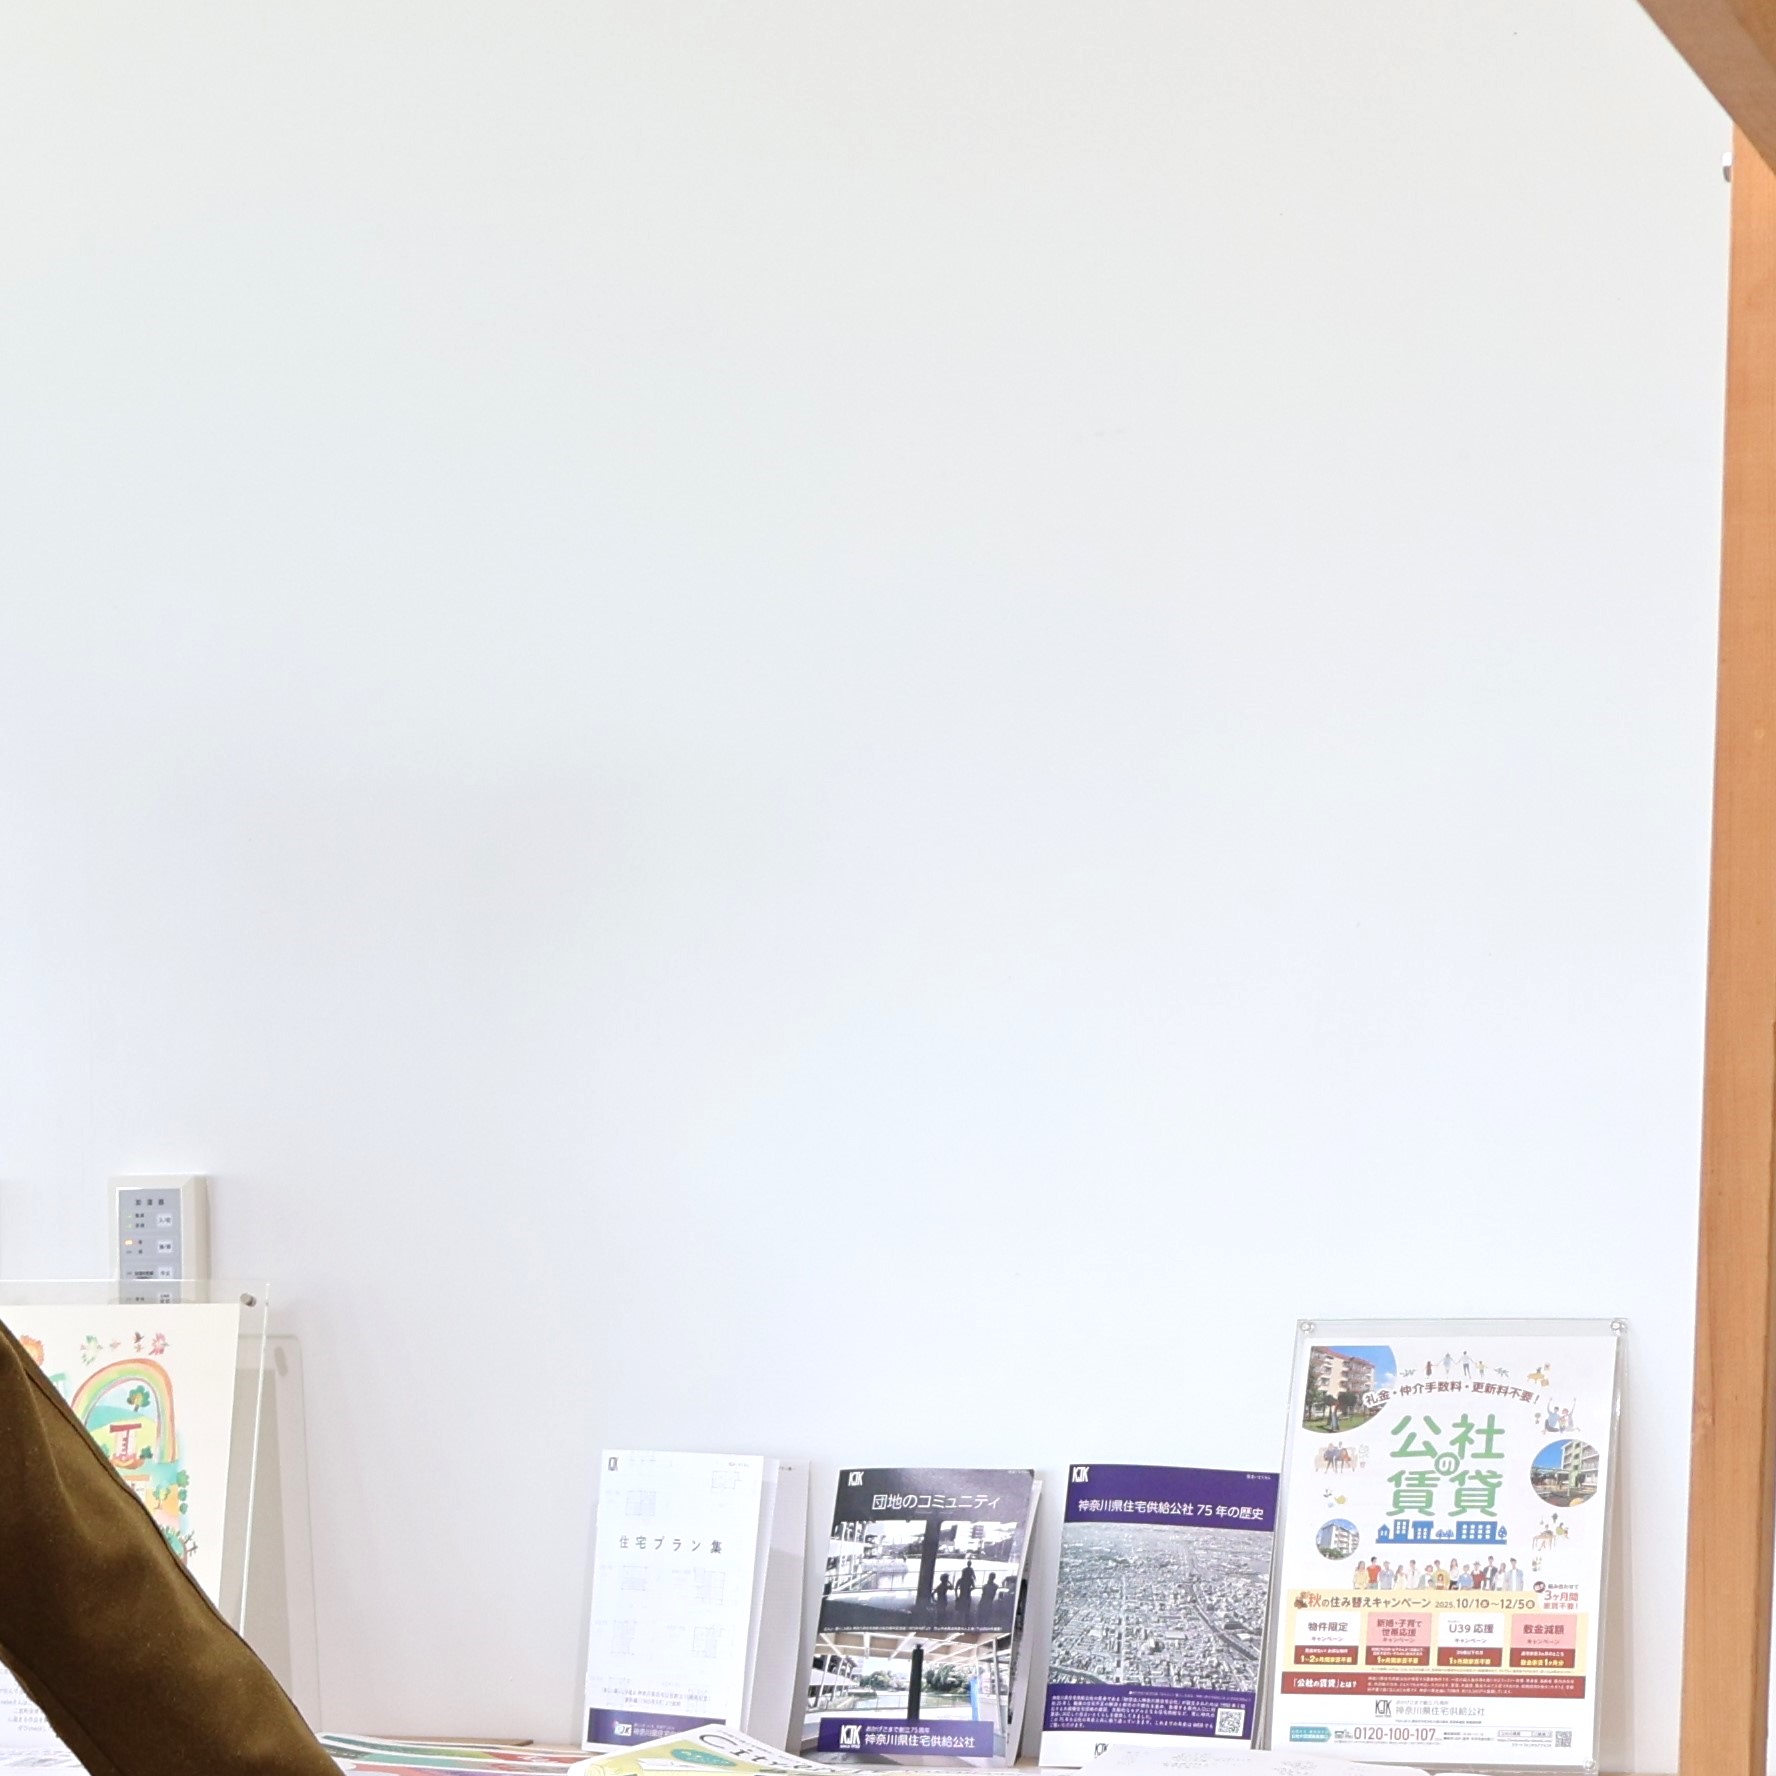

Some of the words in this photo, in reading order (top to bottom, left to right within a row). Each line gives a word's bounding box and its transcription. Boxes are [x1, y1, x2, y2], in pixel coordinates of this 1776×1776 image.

[1390, 1413, 1505, 1459] 公社
[1434, 1452, 1460, 1476] の
[848, 1471, 864, 1487] KJK
[1386, 1470, 1503, 1516] 賃貸
[872, 1493, 1000, 1510] 団地のコミュニティ
[1078, 1499, 1194, 1517] 神奈川県住宅供給公社
[1197, 1504, 1213, 1517] 75
[1215, 1504, 1264, 1521] 年の歴史
[619, 1535, 722, 1554] 住宅プラン集
[1308, 1592, 1432, 1608] 秋の住み替えキャンペーン
[1308, 1622, 1348, 1632] 物件限定
[1381, 1628, 1416, 1637] 世帯応援
[1449, 1624, 1471, 1633] U39
[1473, 1624, 1494, 1634] 応援
[1523, 1624, 1565, 1635] 敷金減額
[1396, 1706, 1485, 1717] 神奈川県住宅供給公社
[840, 1725, 862, 1745] KJK
[865, 1733, 975, 1748] 神奈川県住宅供給公社
[1354, 1726, 1436, 1741] 0120-100-107
